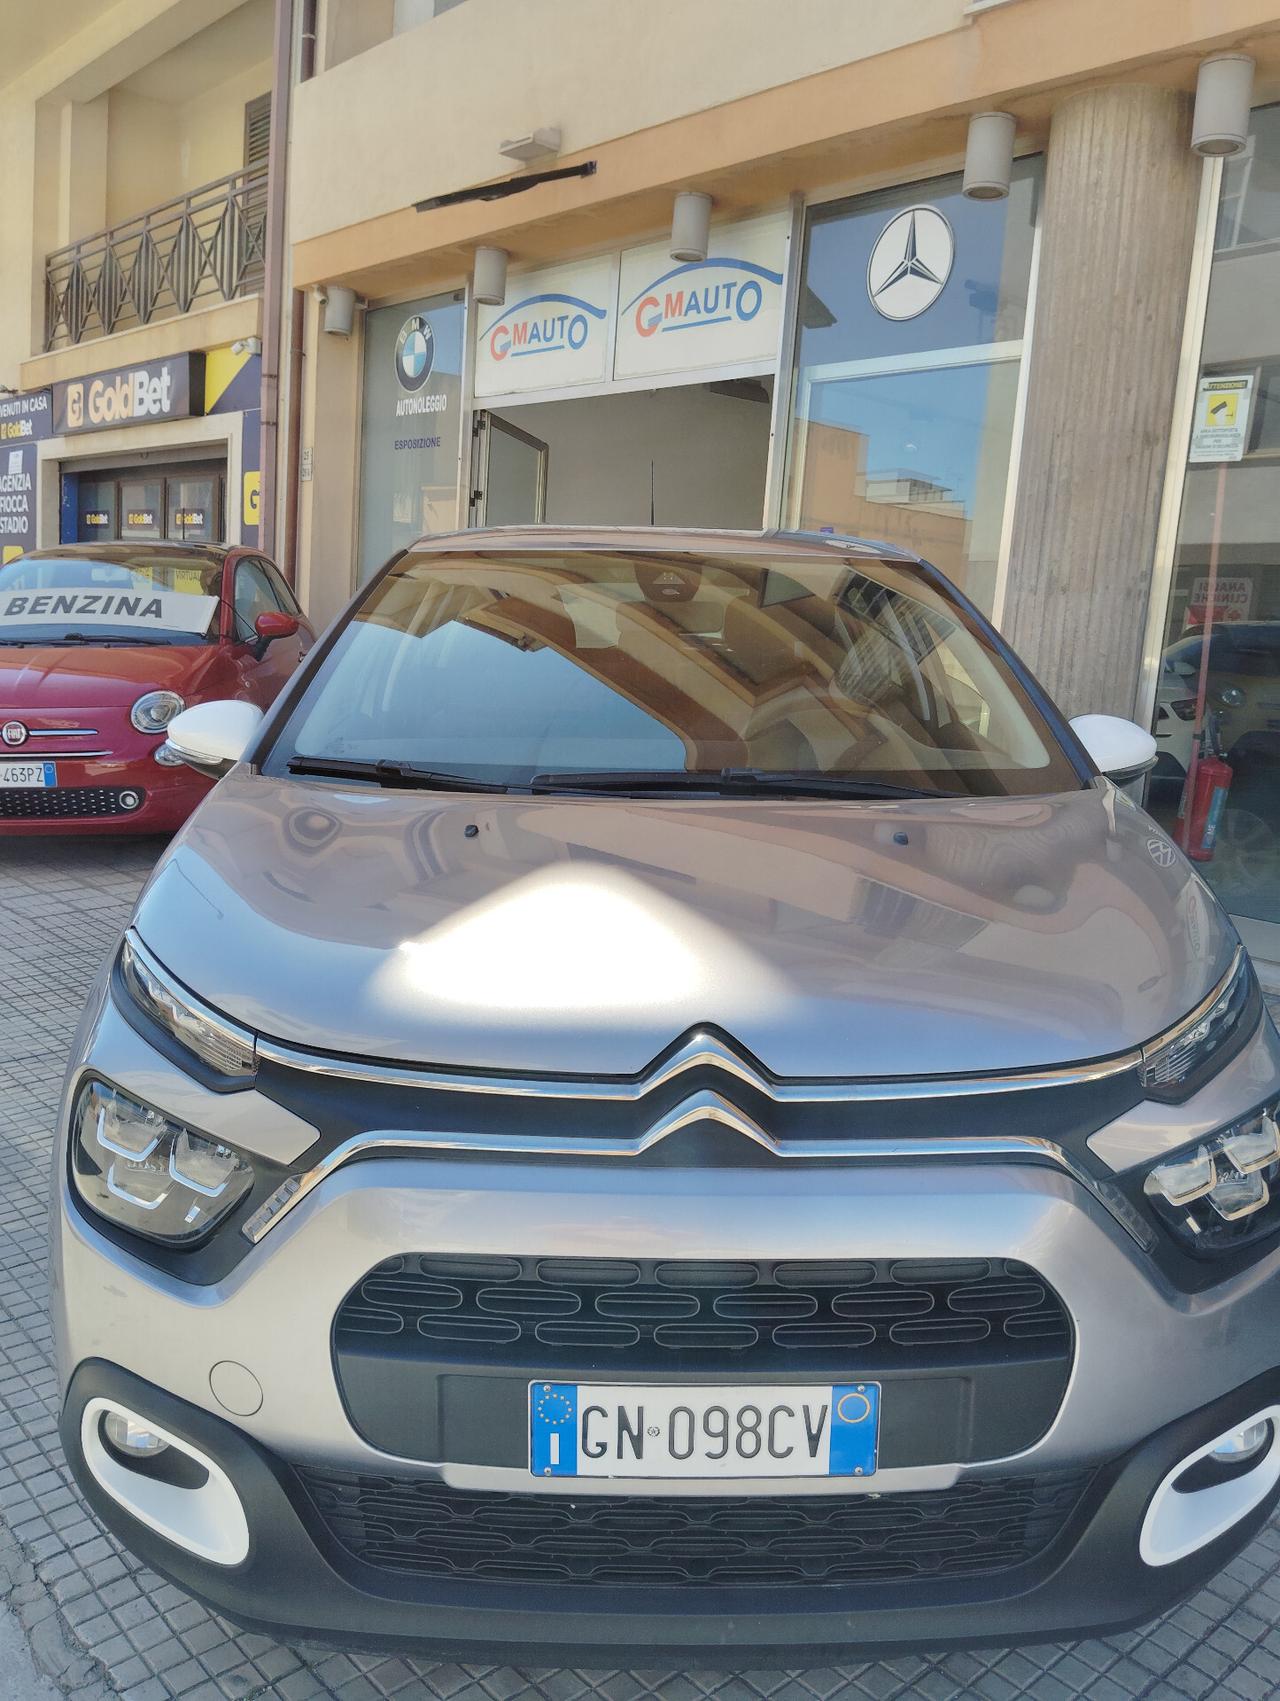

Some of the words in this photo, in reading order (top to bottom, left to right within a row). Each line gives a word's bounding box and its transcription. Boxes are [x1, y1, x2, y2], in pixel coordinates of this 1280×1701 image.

[30, 395, 48, 412] CASA
[88, 366, 171, 424] GoldBet
[396, 394, 447, 416] AUTONOLEGGIO
[394, 436, 441, 450] ESPOSIZIONE
[5, 595, 163, 618] BENZINA
[3, 767, 44, 783] 463PZ
